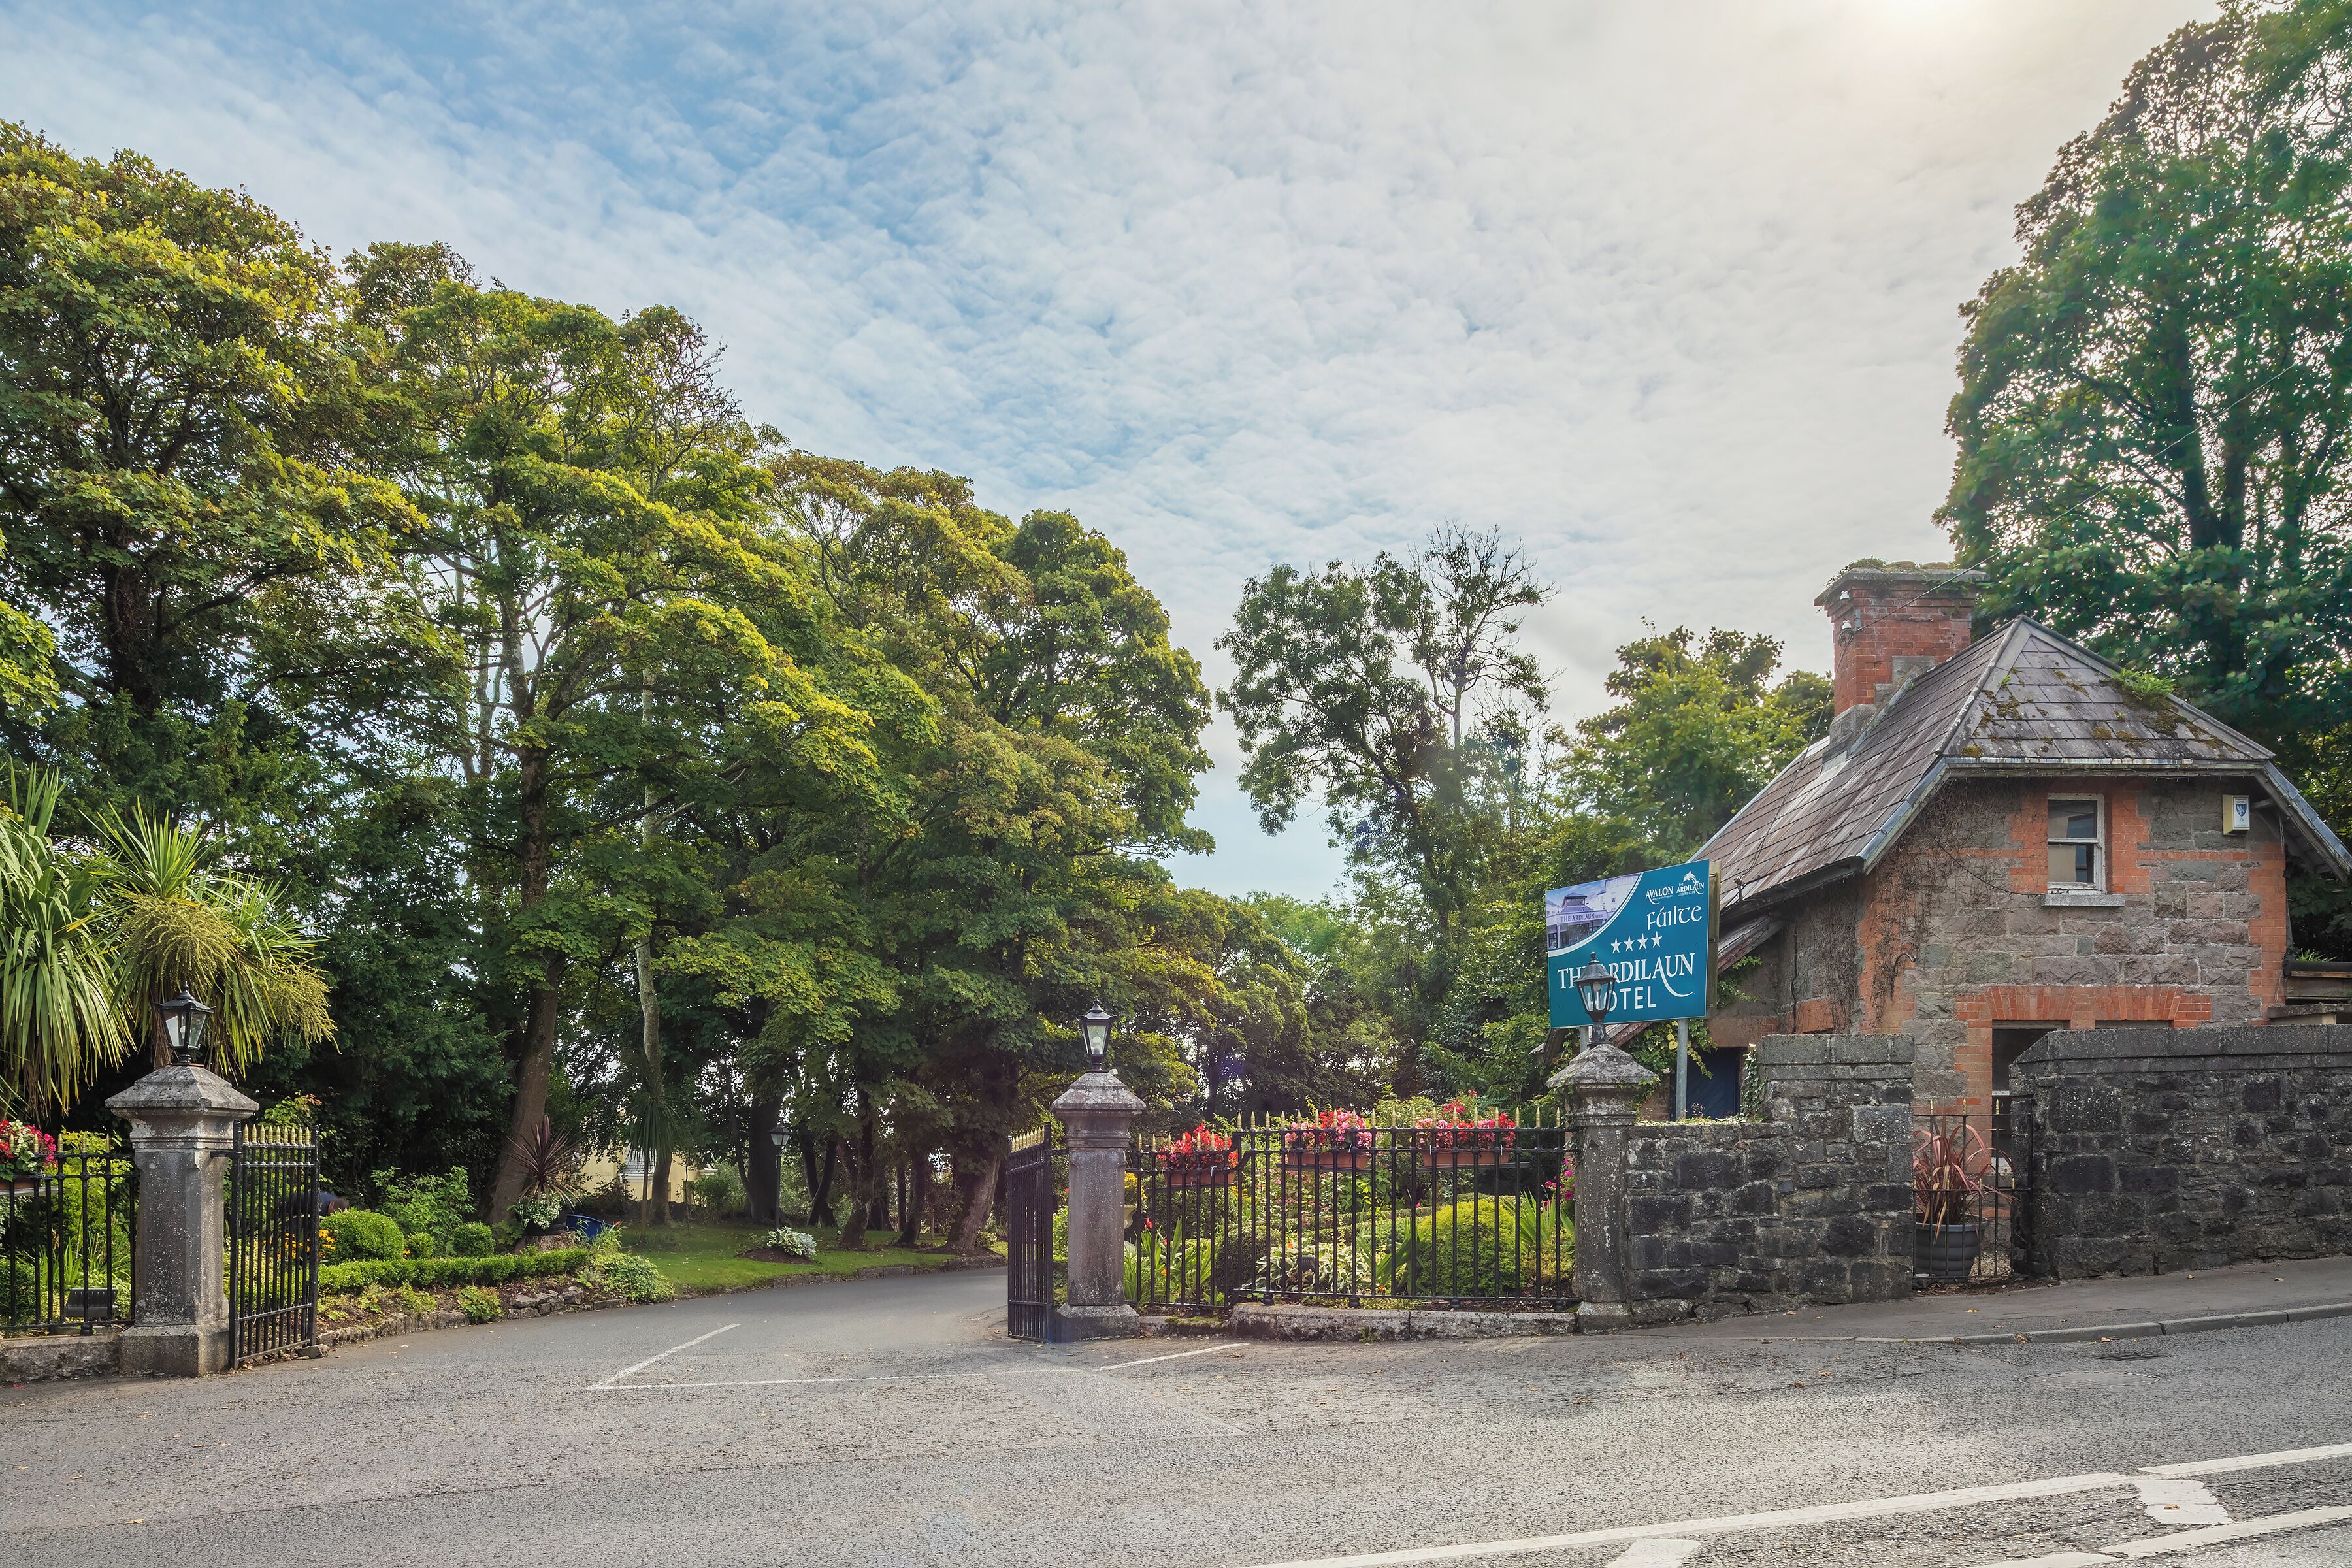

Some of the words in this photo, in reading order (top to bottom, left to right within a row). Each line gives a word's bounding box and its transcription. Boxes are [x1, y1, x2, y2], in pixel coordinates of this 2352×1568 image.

[1645, 886, 1674, 905] AVALON
[1676, 882, 1705, 895] ARDILAUN
[1557, 966, 1586, 989] TH
[1609, 953, 1695, 998] RDILAUN
